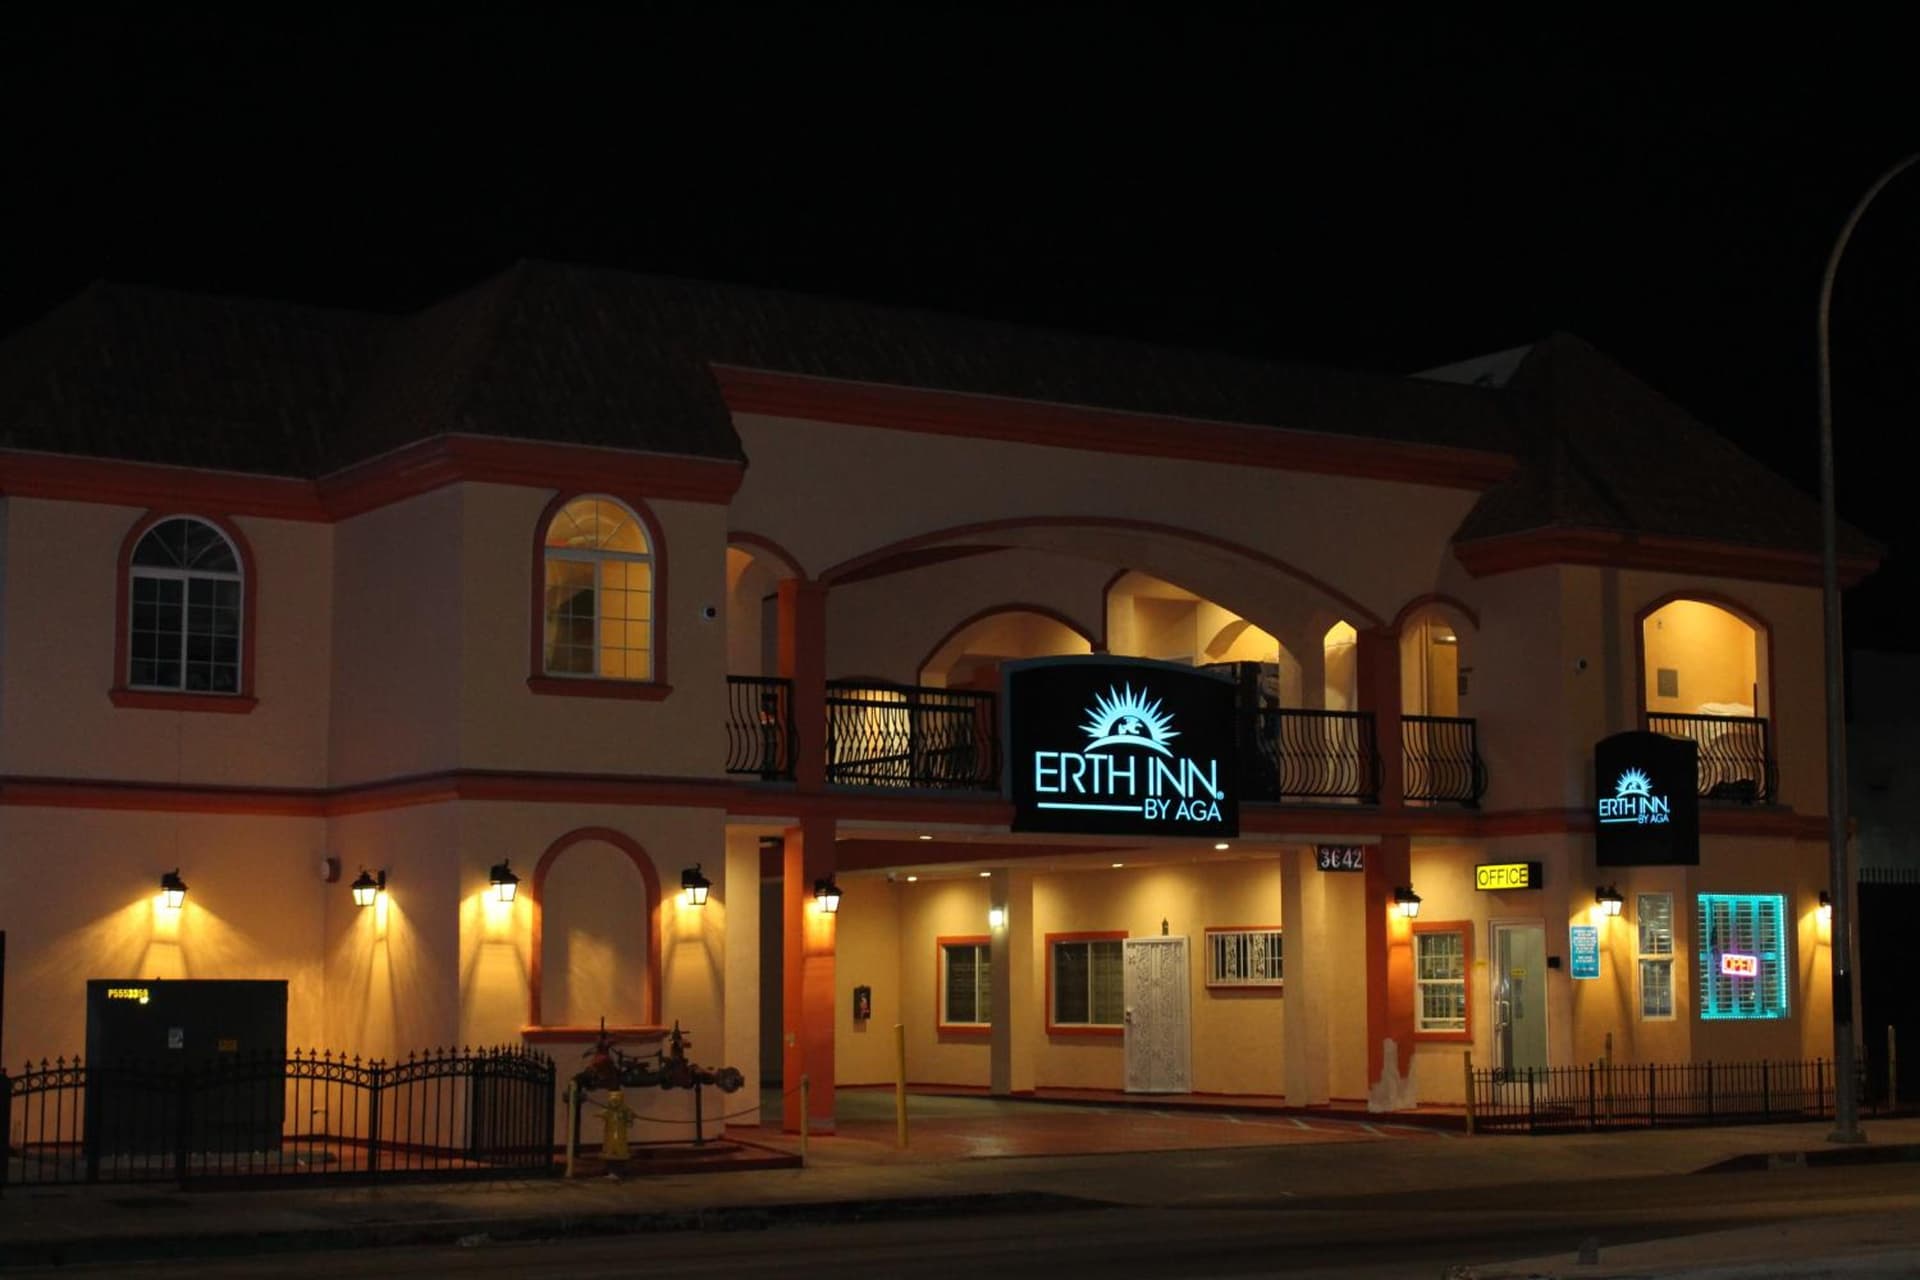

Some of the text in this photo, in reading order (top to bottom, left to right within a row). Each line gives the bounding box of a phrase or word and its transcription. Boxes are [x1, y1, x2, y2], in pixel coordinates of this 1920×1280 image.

[1034, 751, 1136, 796] ERTH
[1144, 798, 1222, 822] BY AGA
[1599, 797, 1636, 816] ERTH
[1638, 813, 1669, 824] BY AGA
[1320, 847, 1363, 869] 3642
[1478, 867, 1528, 886] OFFICE
[1723, 955, 1754, 974] OPEN
